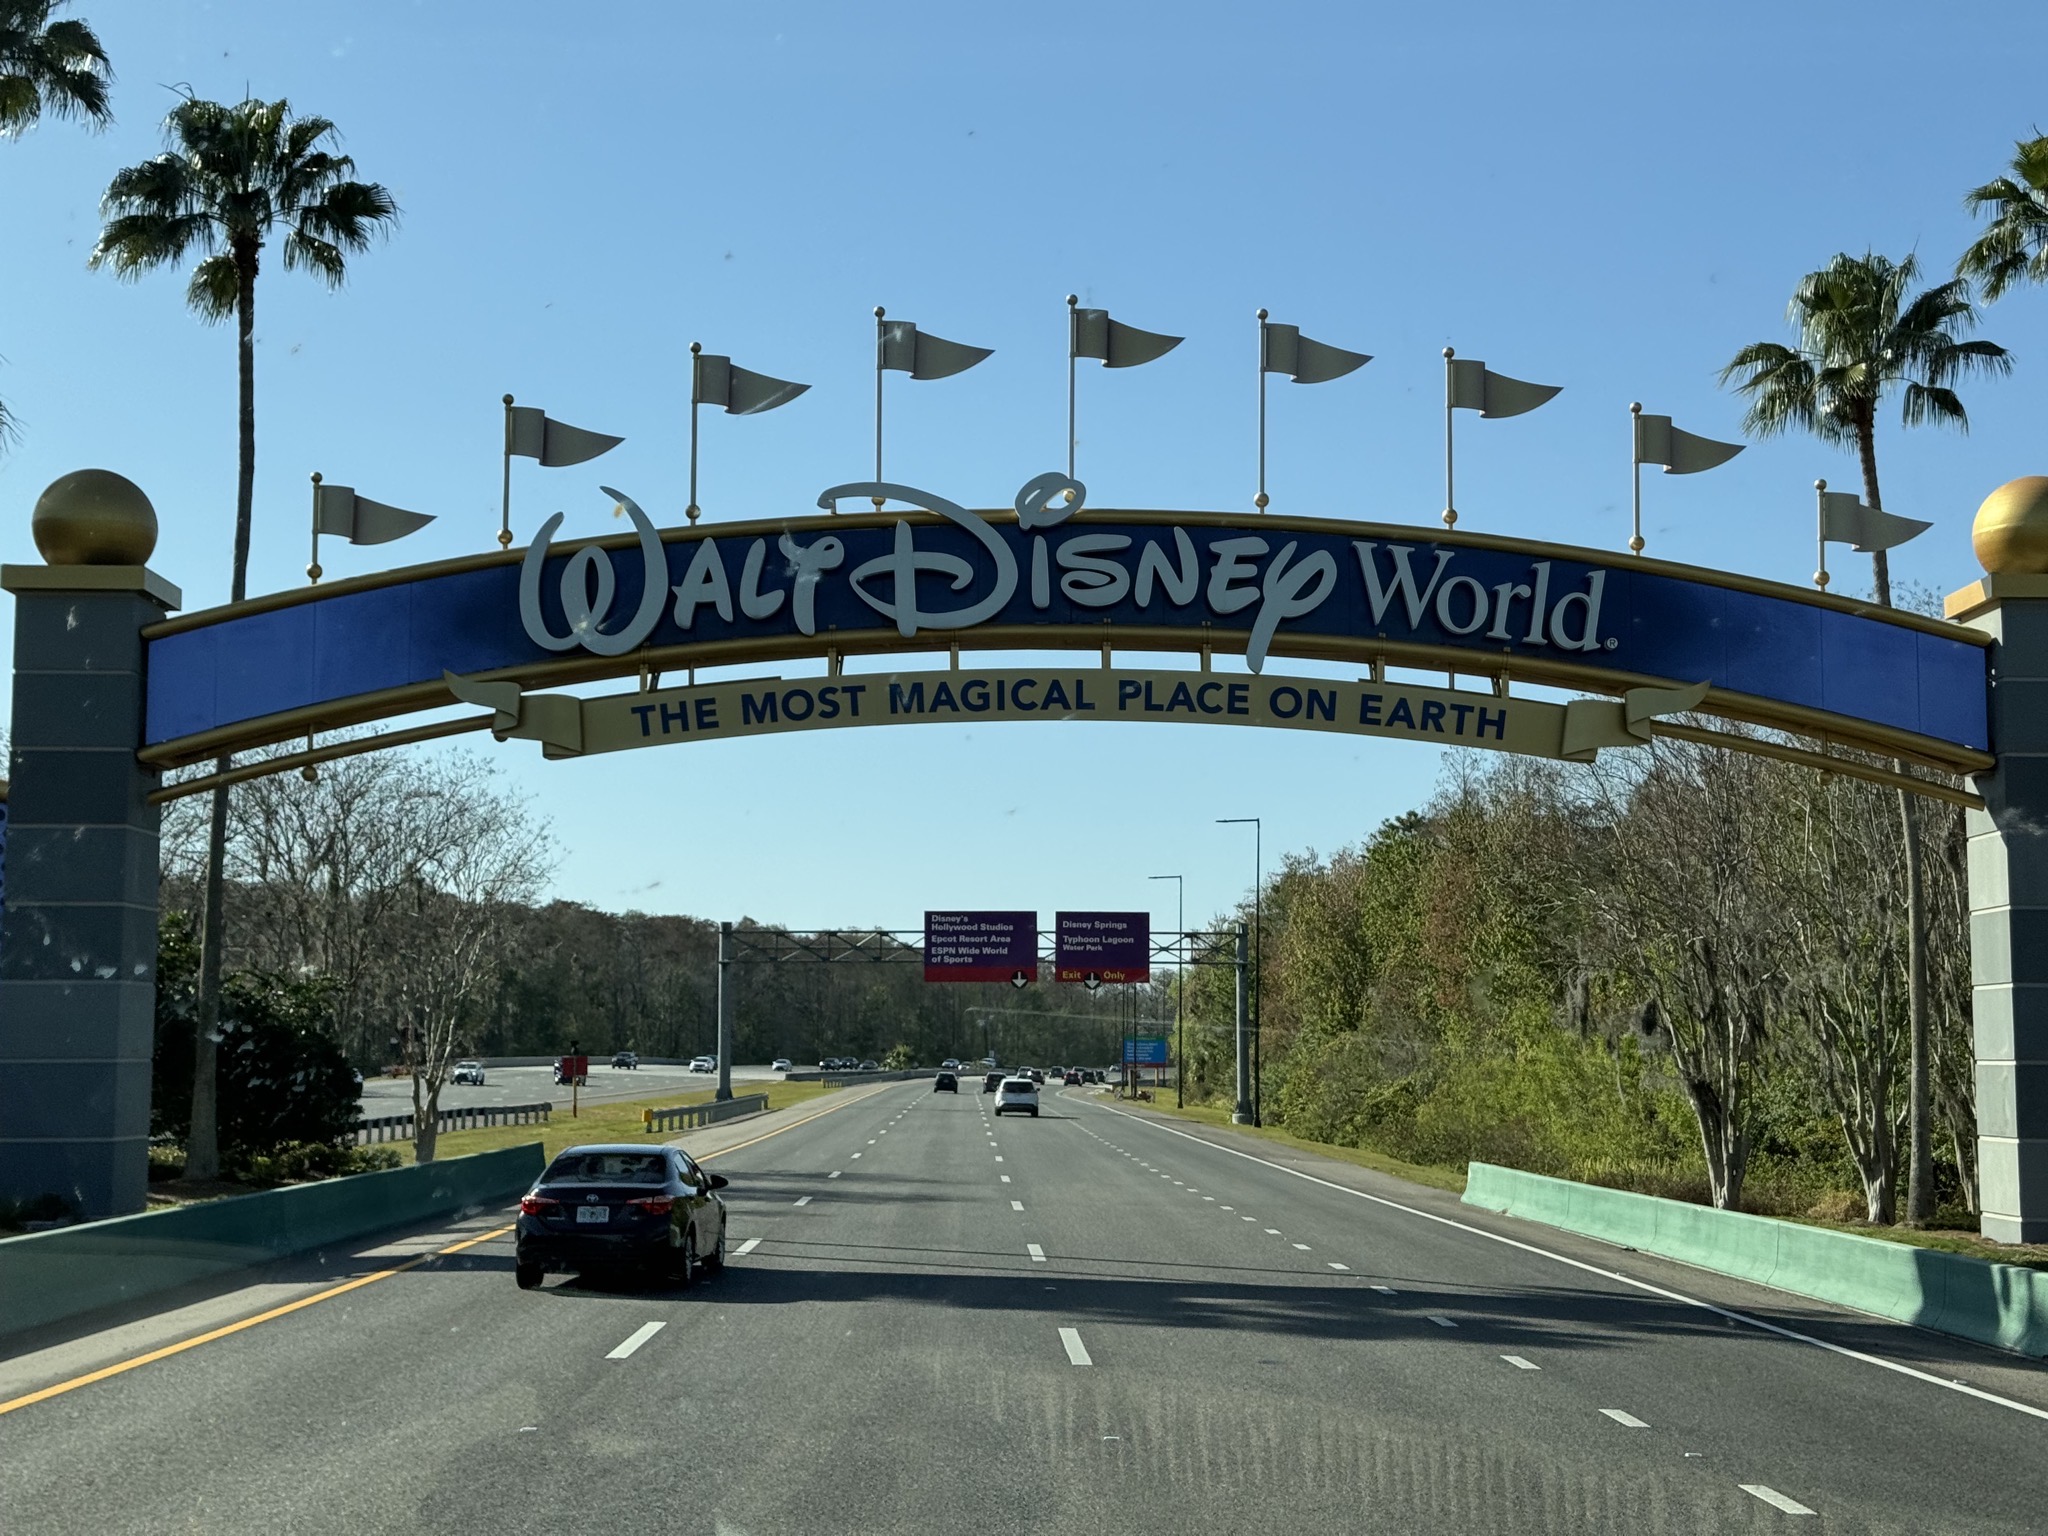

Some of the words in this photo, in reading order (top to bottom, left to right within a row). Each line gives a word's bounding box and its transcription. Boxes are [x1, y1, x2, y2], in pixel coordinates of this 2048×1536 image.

[631, 698, 720, 738] THE
[742, 685, 866, 726] MOST
[890, 678, 1095, 714] MAGICAL
[1118, 681, 1250, 715] PLACE
[1269, 686, 1339, 722] ON
[1359, 695, 1507, 740] EARTH
[932, 915, 968, 923] Disney's
[1063, 921, 1092, 929] Disney
[1094, 921, 1127, 930] Springs
[932, 935, 956, 943] Epcot
[1063, 936, 1099, 944] Typhoon
[1102, 936, 1134, 944] Lagoon
[943, 956, 972, 964] Sports
[1063, 971, 1081, 979] Exit
[1103, 971, 1125, 980] Only
